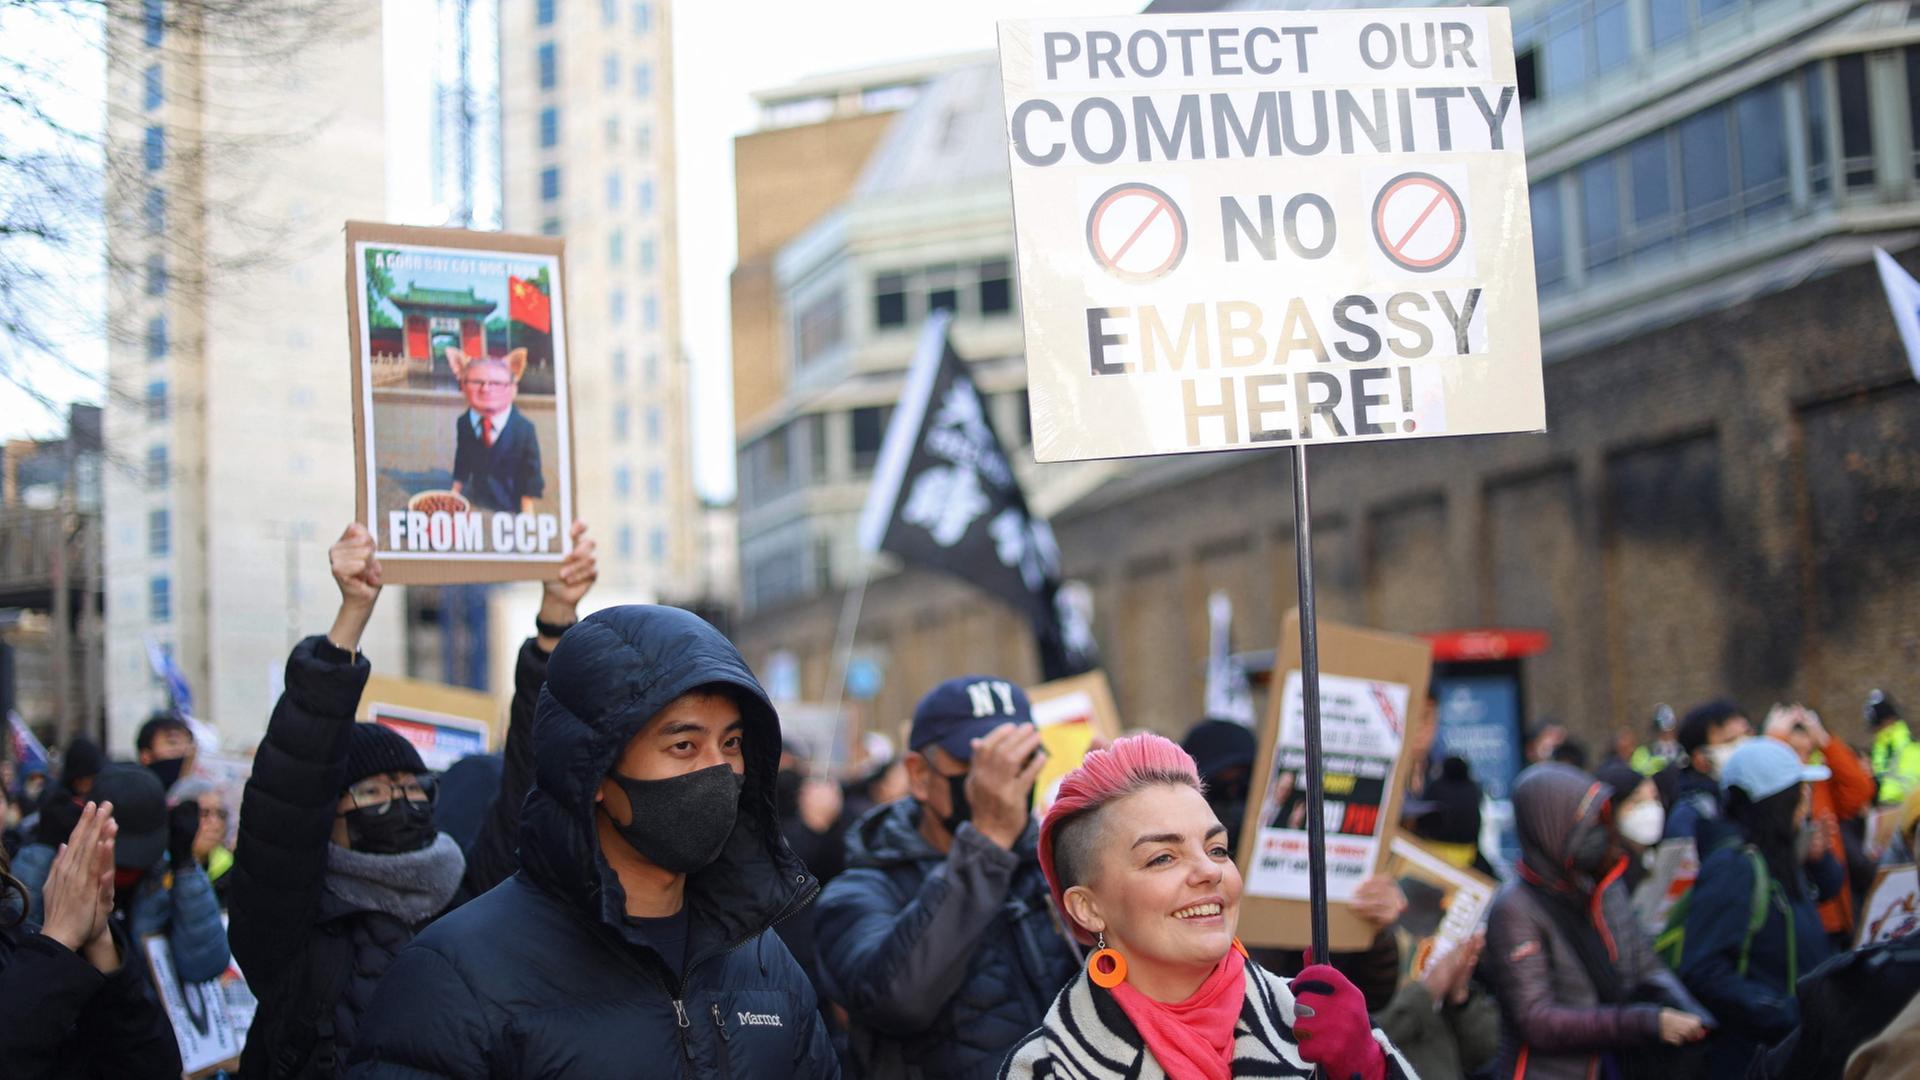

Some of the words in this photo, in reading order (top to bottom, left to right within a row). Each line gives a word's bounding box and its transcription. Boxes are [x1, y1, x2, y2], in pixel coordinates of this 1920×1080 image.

[1043, 26, 1319, 81] PROTECT
[1358, 22, 1478, 71] OUR
[1011, 86, 1517, 168] COMMUNITY
[1219, 192, 1338, 263] NO
[1086, 287, 1483, 377] EMBASSY
[1182, 366, 1417, 447] HERE!
[389, 510, 484, 552] FROM
[491, 511, 558, 554] CCP
[966, 681, 1016, 718] NY
[737, 1011, 783, 1027] Marmot
